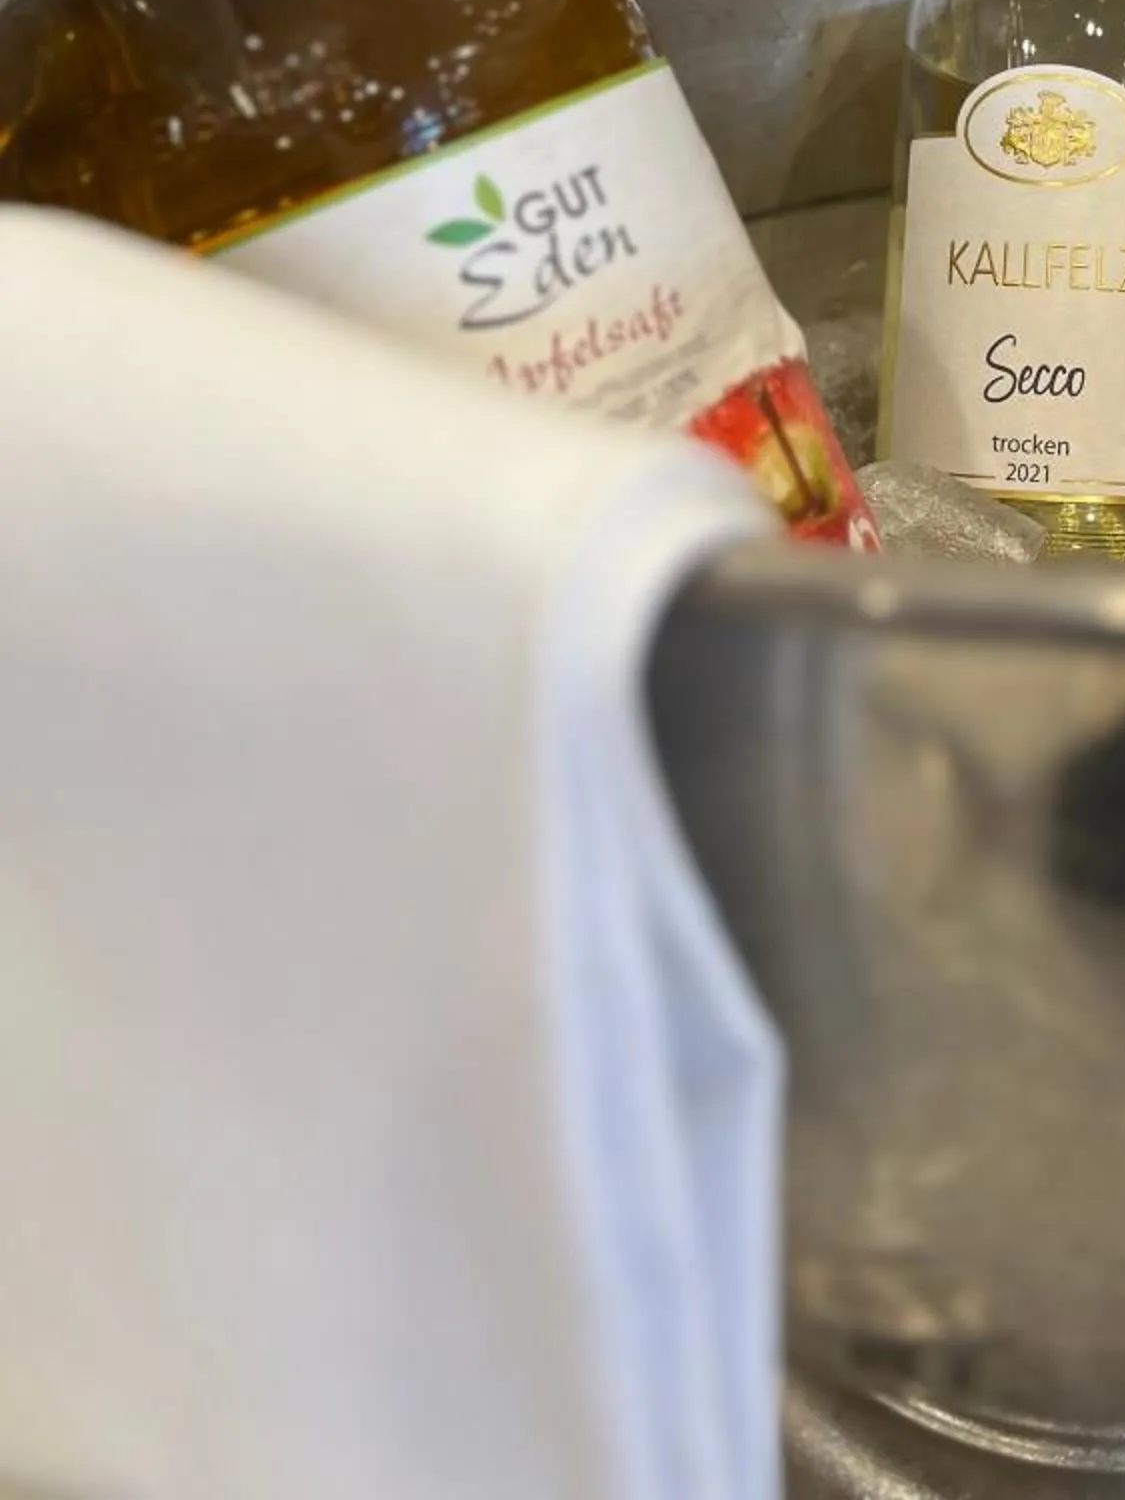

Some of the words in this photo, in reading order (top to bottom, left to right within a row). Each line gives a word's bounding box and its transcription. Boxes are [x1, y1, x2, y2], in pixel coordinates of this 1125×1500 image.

[513, 165, 607, 235] GUT
[458, 225, 639, 331] Eden
[982, 333, 1086, 402] Secco
[991, 434, 1071, 456] trocken
[1004, 463, 1051, 483] 2021
